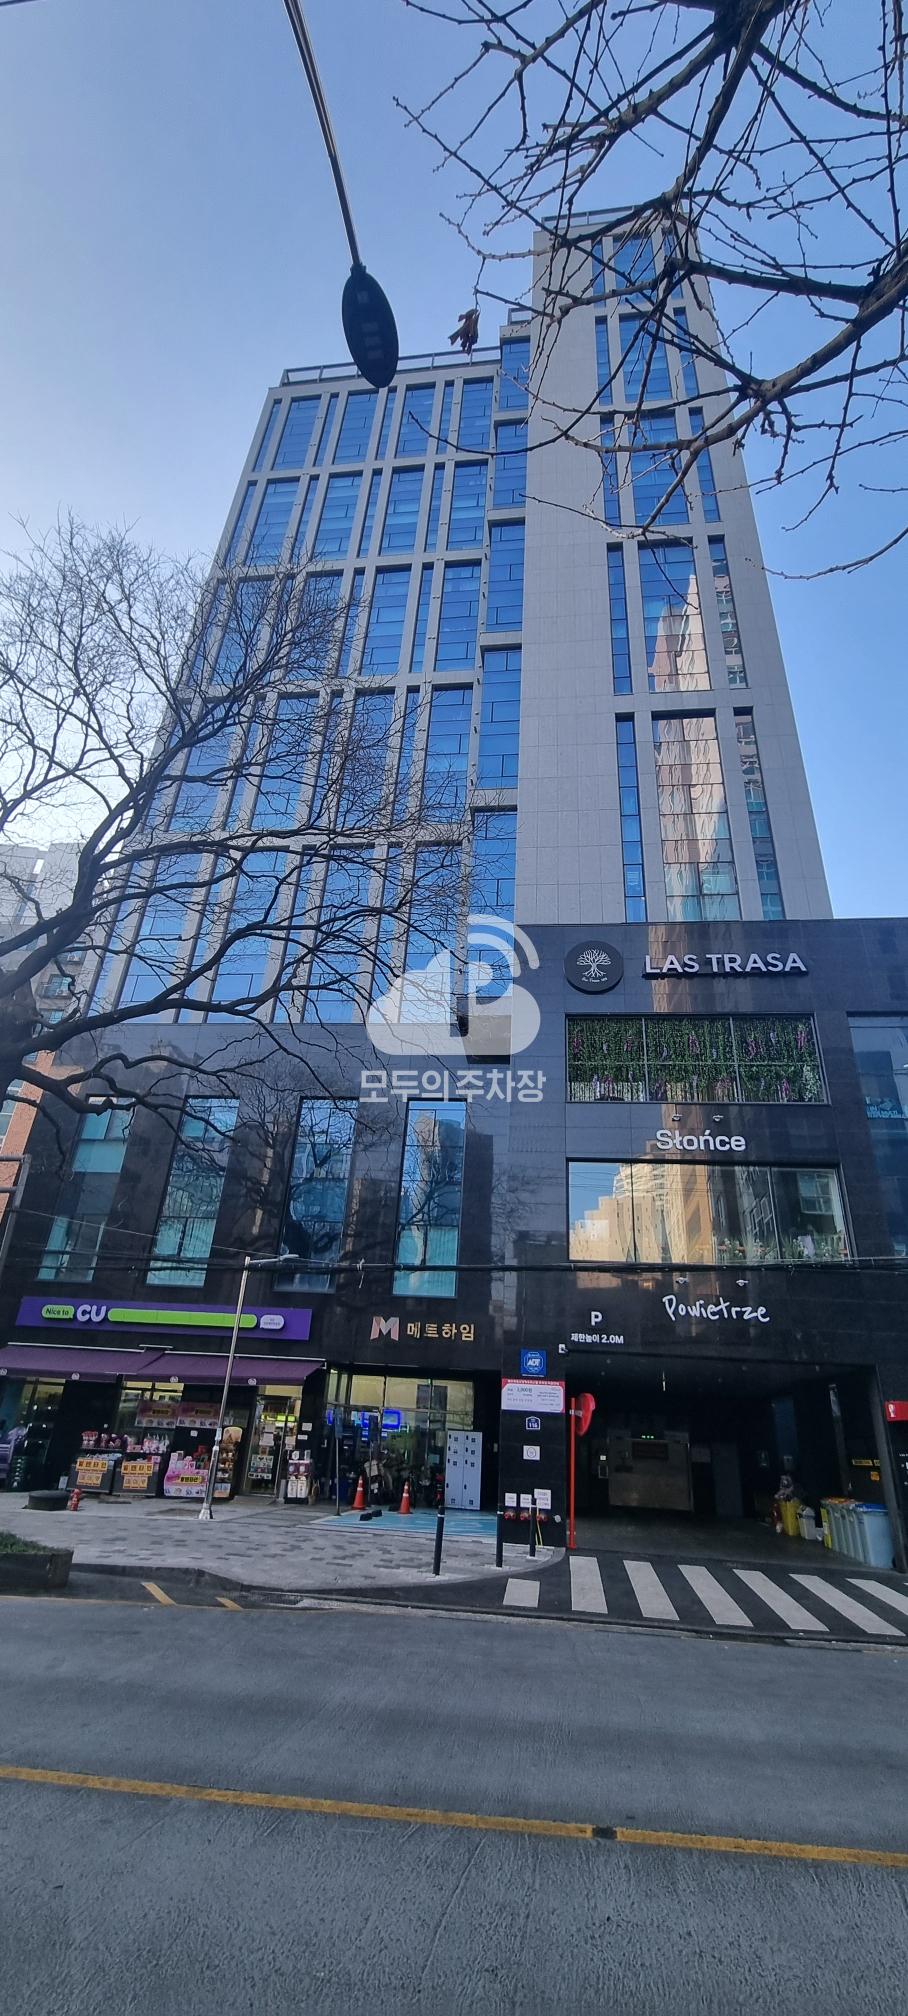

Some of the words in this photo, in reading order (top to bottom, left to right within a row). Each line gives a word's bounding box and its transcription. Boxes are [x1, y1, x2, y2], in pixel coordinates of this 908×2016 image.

[645, 954, 700, 973] LAS
[705, 952, 808, 972] TRASA
[656, 1129, 746, 1151] Słońce
[45, 1307, 60, 1315] Nice
[76, 1304, 107, 1322] CU
[590, 1310, 603, 1326] P
[662, 1294, 770, 1323] Powietrze
[406, 1321, 475, 1341] 메트하임
[570, 1332, 600, 1344] 제한높이
[601, 1334, 625, 1344] 2.0M
